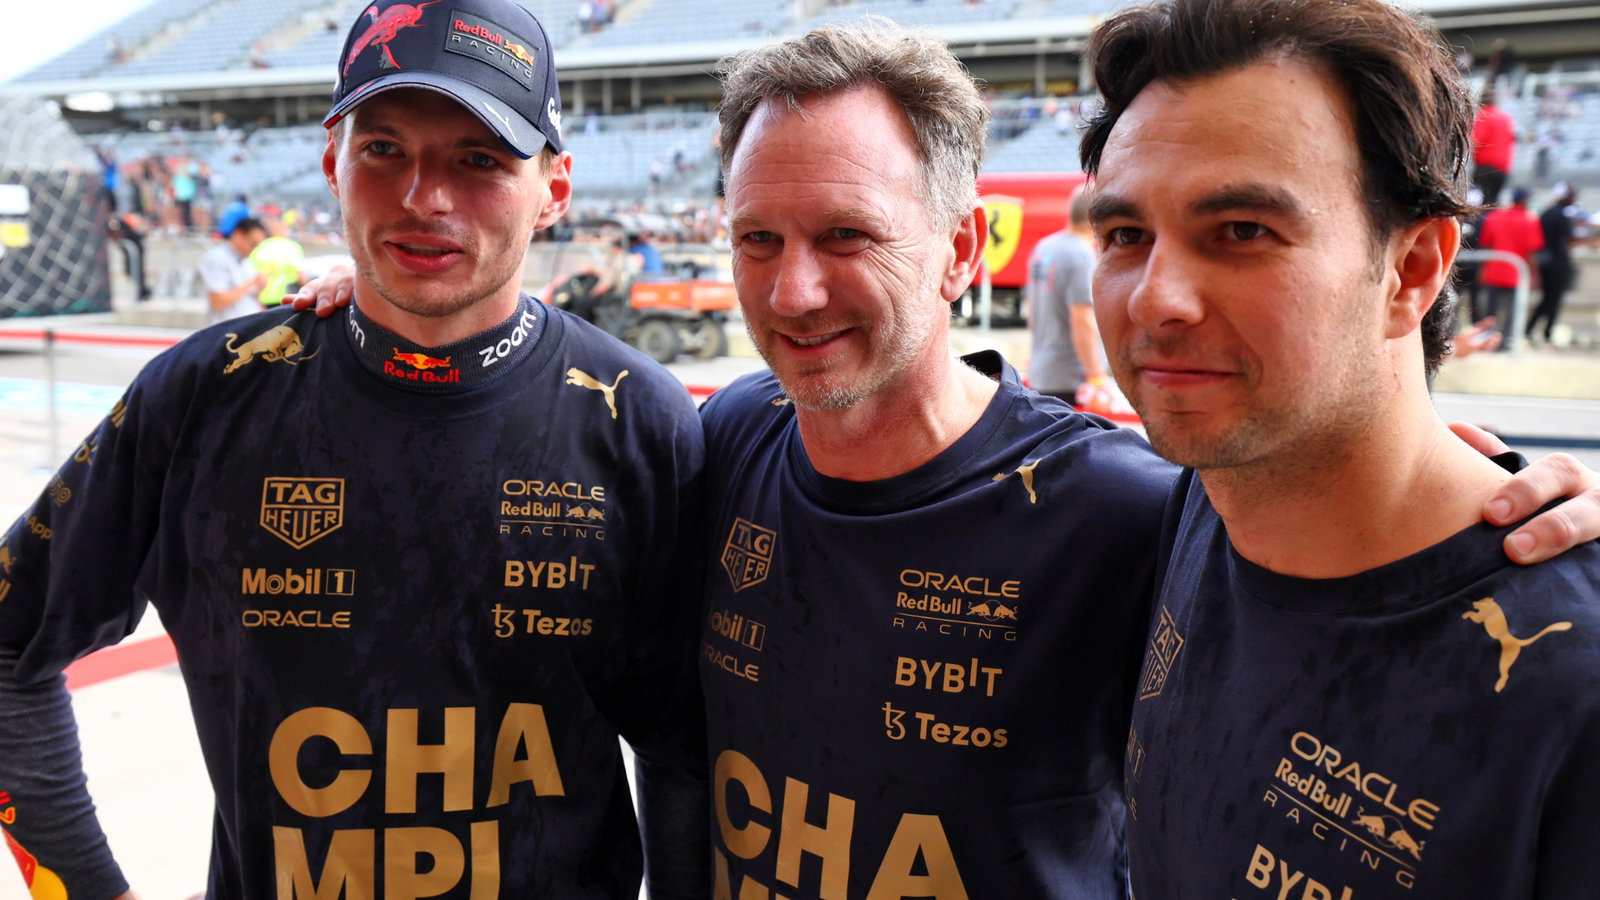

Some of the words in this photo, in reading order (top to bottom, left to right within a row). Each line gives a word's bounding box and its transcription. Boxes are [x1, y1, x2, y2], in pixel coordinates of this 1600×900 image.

[452, 35, 533, 78] RACING
[479, 310, 537, 367] zoom
[270, 483, 336, 504] TAG
[502, 479, 606, 502] ORACLE
[265, 509, 338, 543] HEUER
[500, 524, 605, 541] RACING
[241, 568, 321, 595] Mobil
[334, 571, 345, 593] 1
[504, 556, 596, 590] BYBIT
[899, 569, 1022, 598] ORACLE
[242, 609, 352, 628] ORACLE
[523, 608, 594, 636] Tezos
[708, 604, 744, 642] obil
[750, 624, 758, 647] 1
[893, 617, 1017, 641] RACING
[703, 643, 760, 682] RACLE
[895, 656, 1003, 697] BYBIT
[915, 711, 1009, 749] Tezos
[268, 702, 566, 818] CHA
[1290, 731, 1441, 831] ORACLE
[713, 749, 971, 900] CHA
[1263, 790, 1416, 889] RACING
